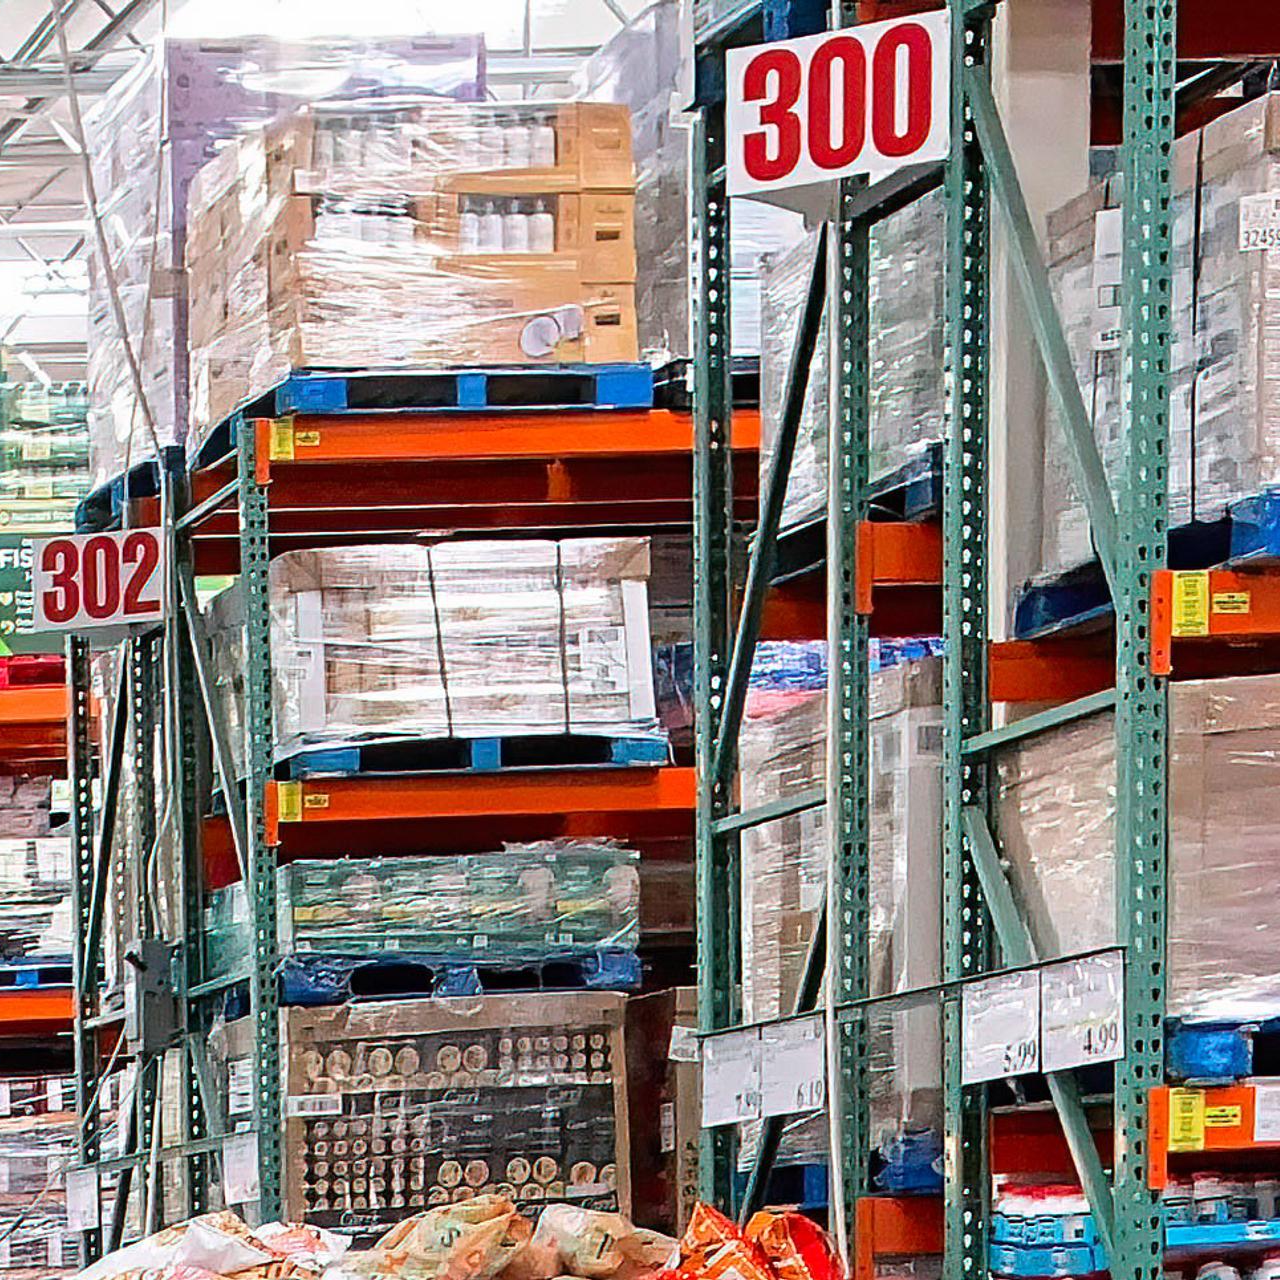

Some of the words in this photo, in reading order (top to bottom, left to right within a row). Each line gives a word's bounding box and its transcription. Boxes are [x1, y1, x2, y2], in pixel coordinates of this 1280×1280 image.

[742, 22, 932, 182] 300
[41, 531, 161, 623] 302
[1083, 1021, 1118, 1055] 4.99
